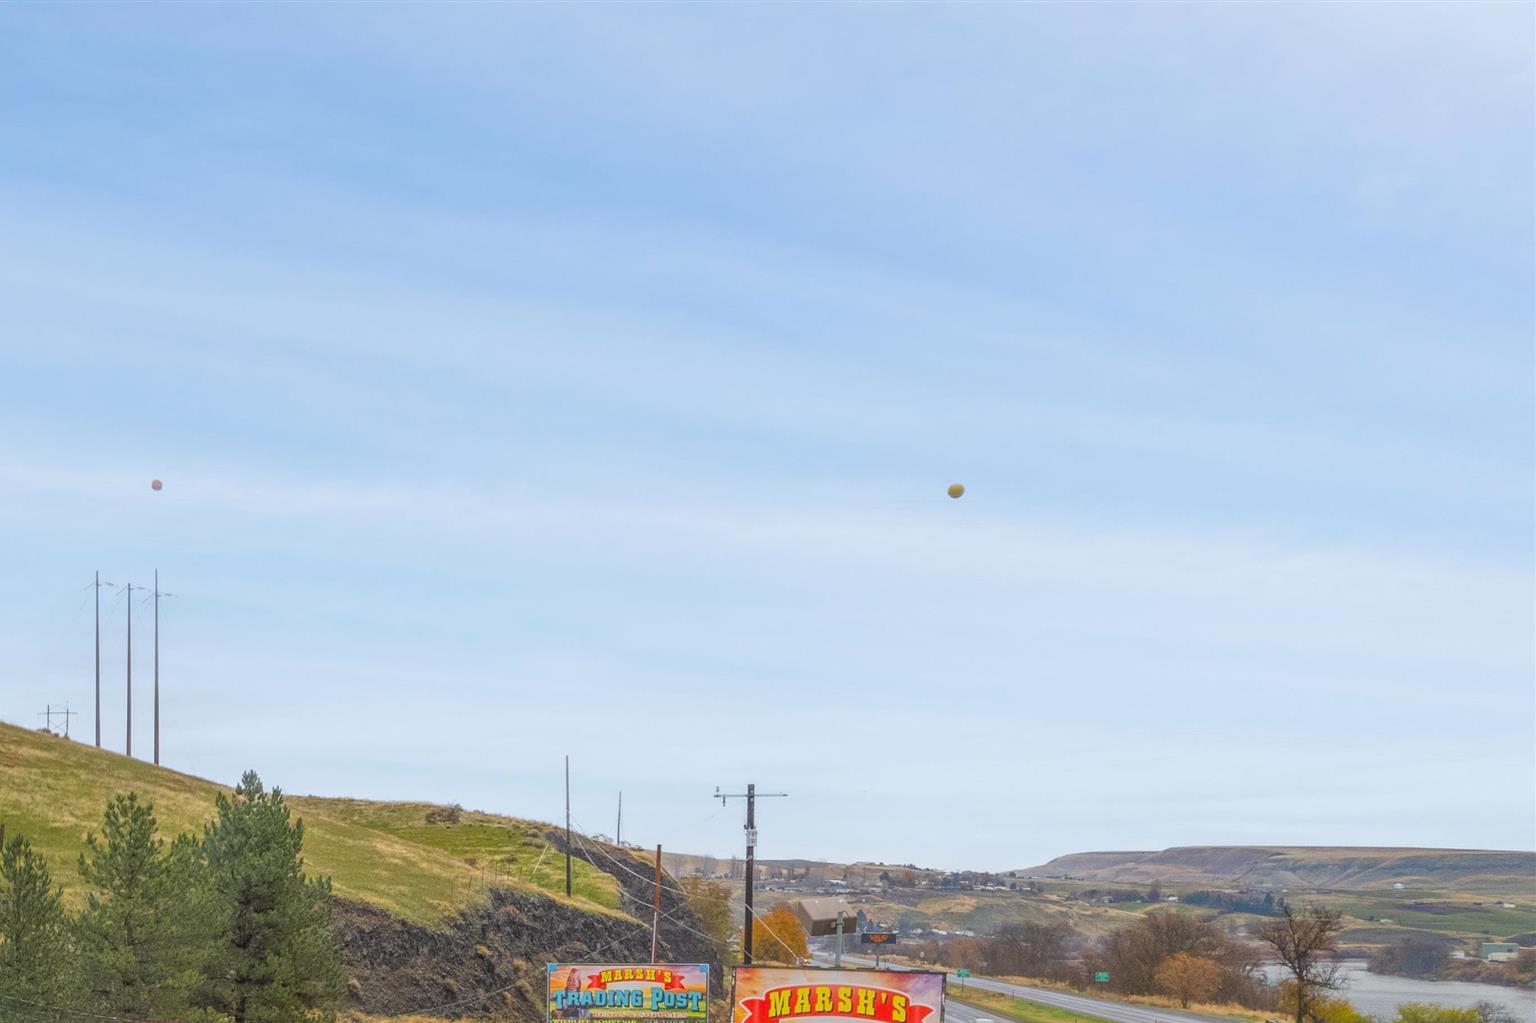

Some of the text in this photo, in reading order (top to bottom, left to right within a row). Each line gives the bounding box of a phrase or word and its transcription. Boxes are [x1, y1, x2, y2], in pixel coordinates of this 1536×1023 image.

[600, 968, 673, 983] MARSH'S
[553, 987, 703, 1012] TRADING POST
[768, 986, 908, 1023] MARSH'S
